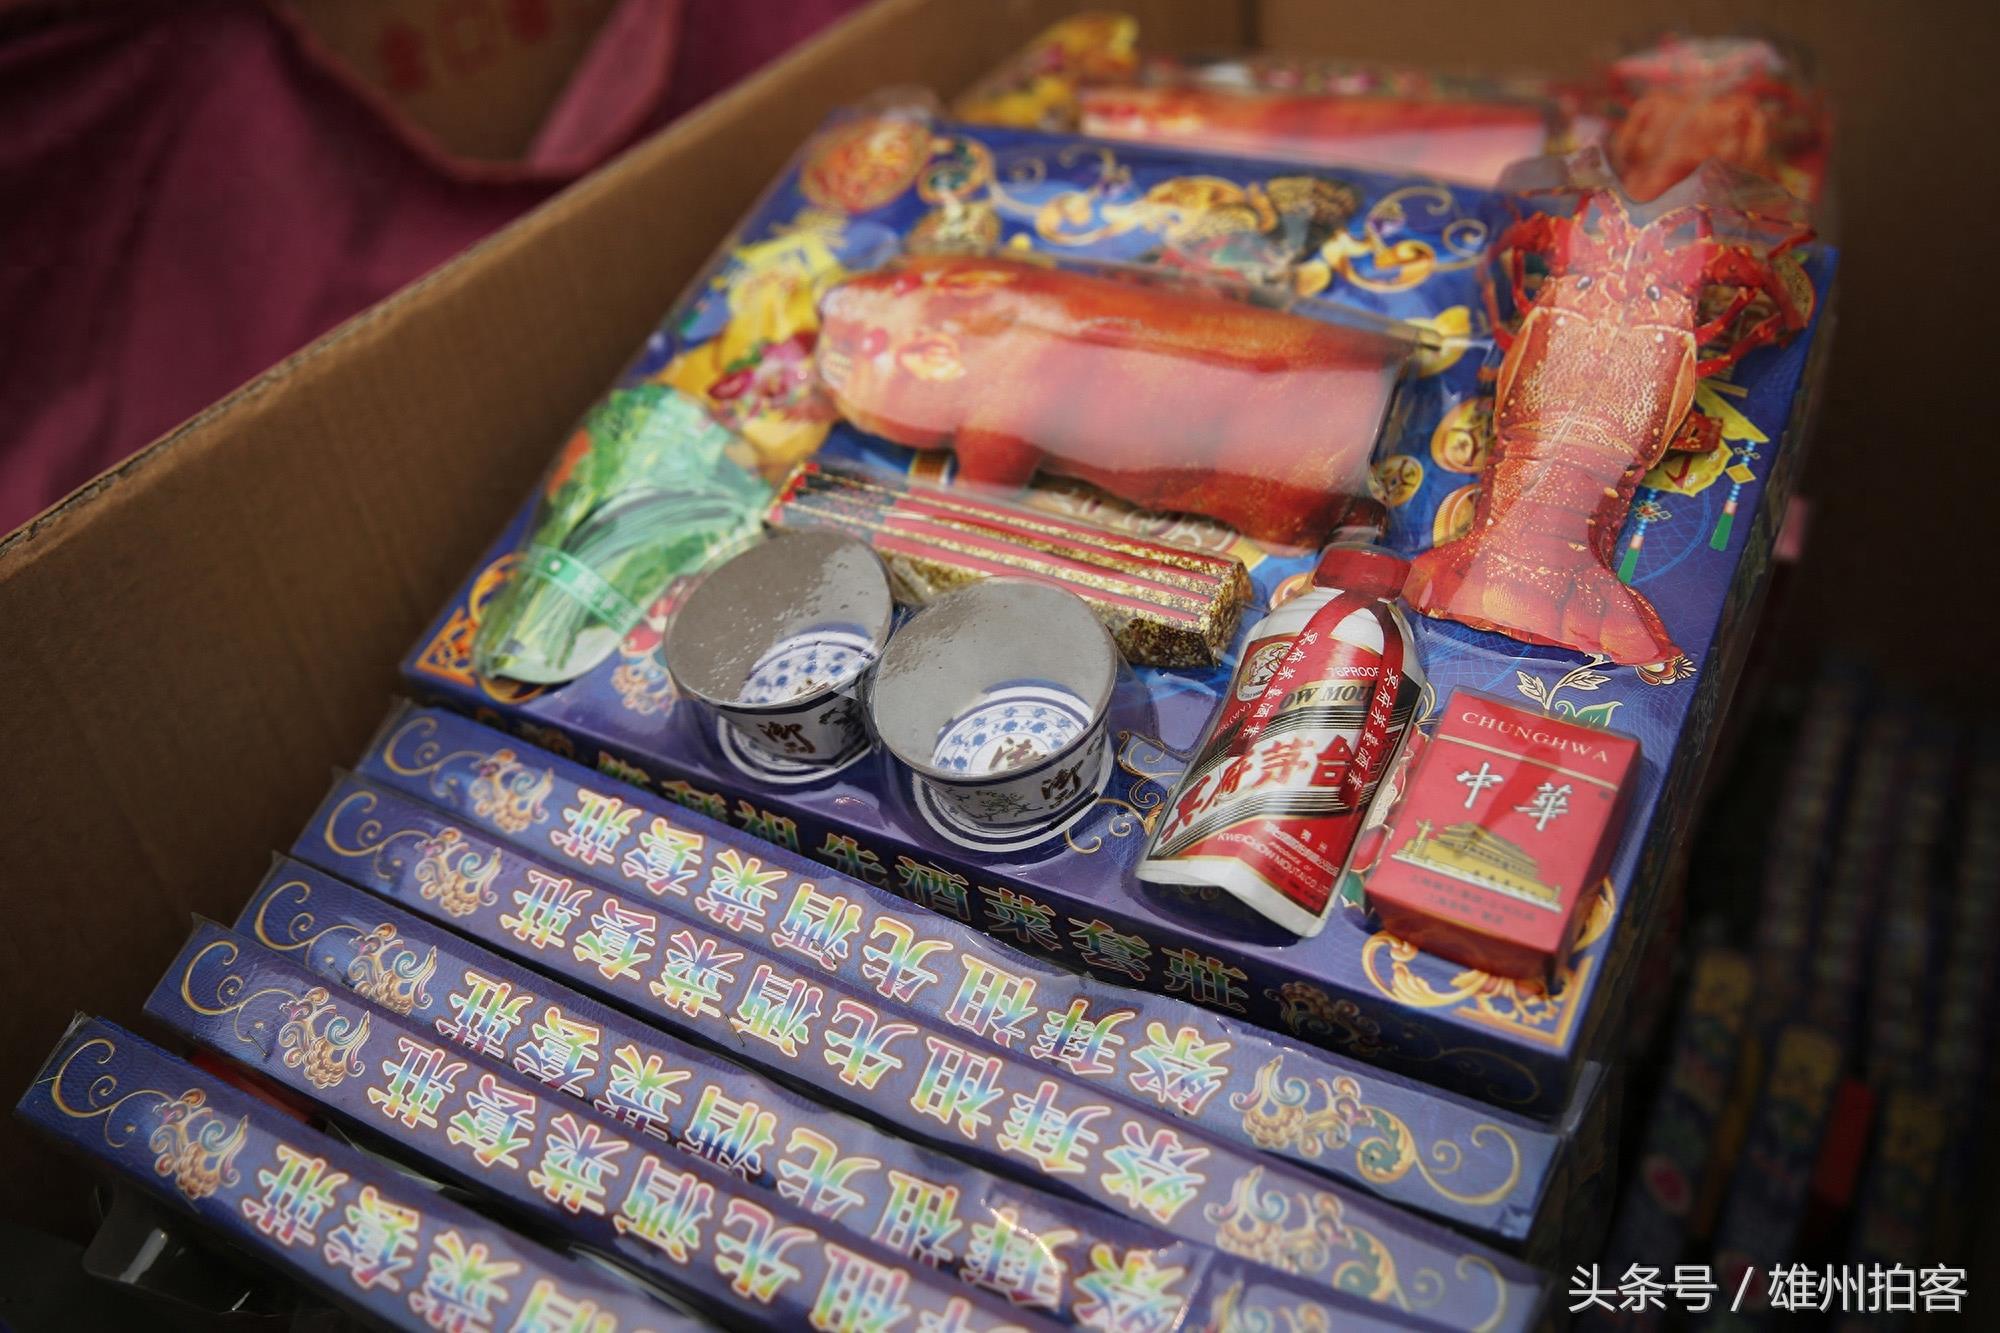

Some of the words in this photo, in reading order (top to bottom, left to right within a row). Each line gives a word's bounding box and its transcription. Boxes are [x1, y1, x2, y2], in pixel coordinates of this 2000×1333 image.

[1462, 711, 1609, 763] CHUNGHWA
[1161, 732, 1396, 845] 冥府茅台
[1456, 761, 1573, 832] 中華
